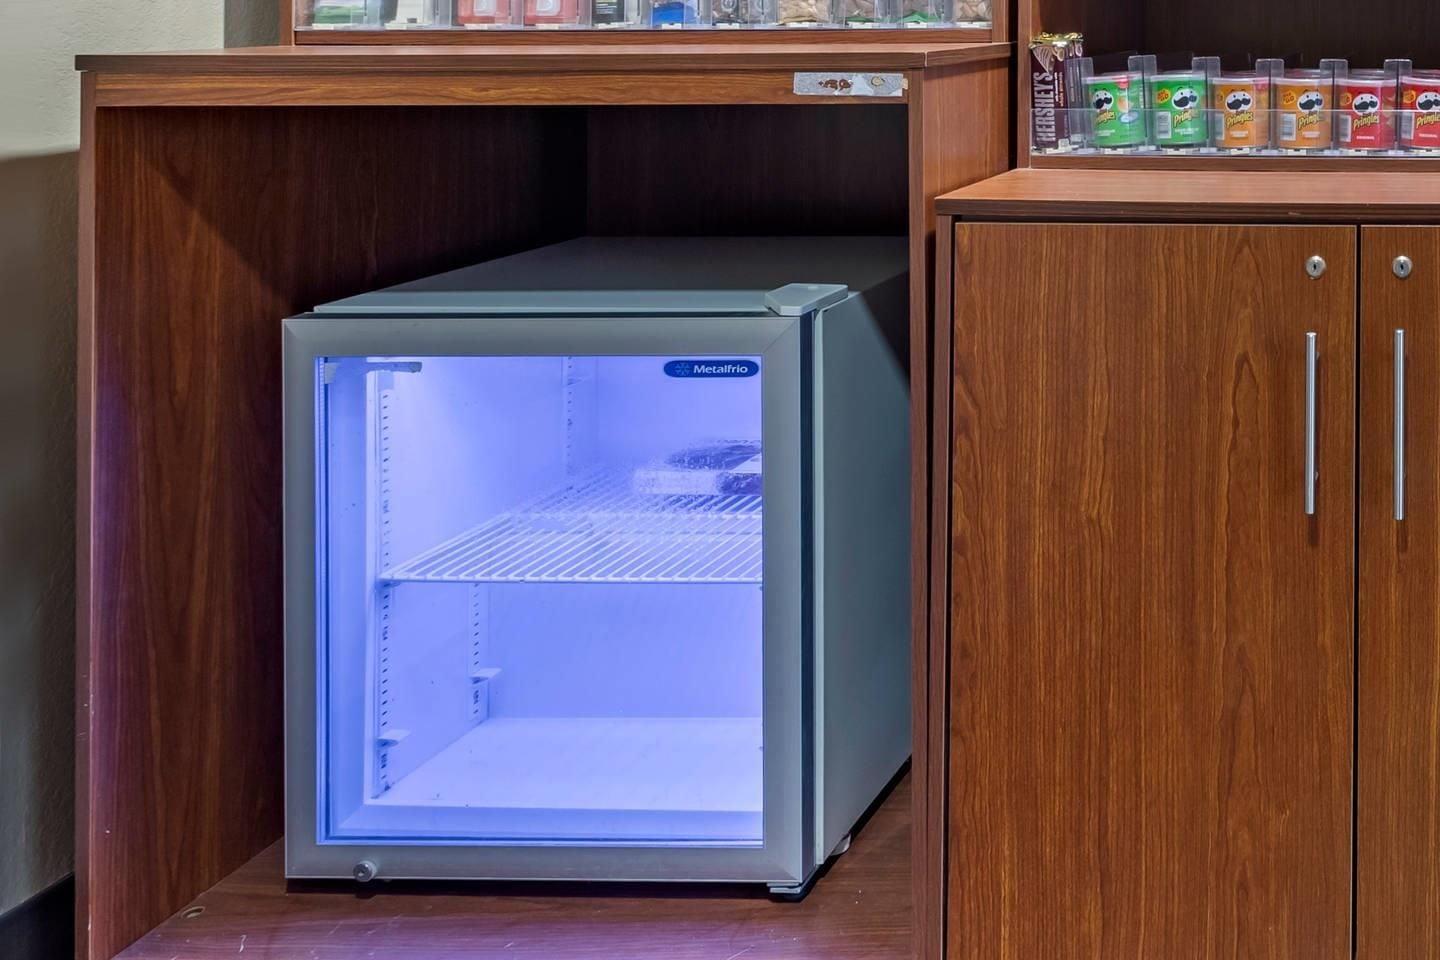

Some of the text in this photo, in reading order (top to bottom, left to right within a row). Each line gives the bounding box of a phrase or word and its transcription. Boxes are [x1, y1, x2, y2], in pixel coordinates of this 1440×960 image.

[1032, 71, 1056, 142] HERSHEY'S
[1226, 111, 1254, 129] Pringles
[1353, 113, 1379, 132] Pringles
[693, 363, 748, 374] Metalfrio
